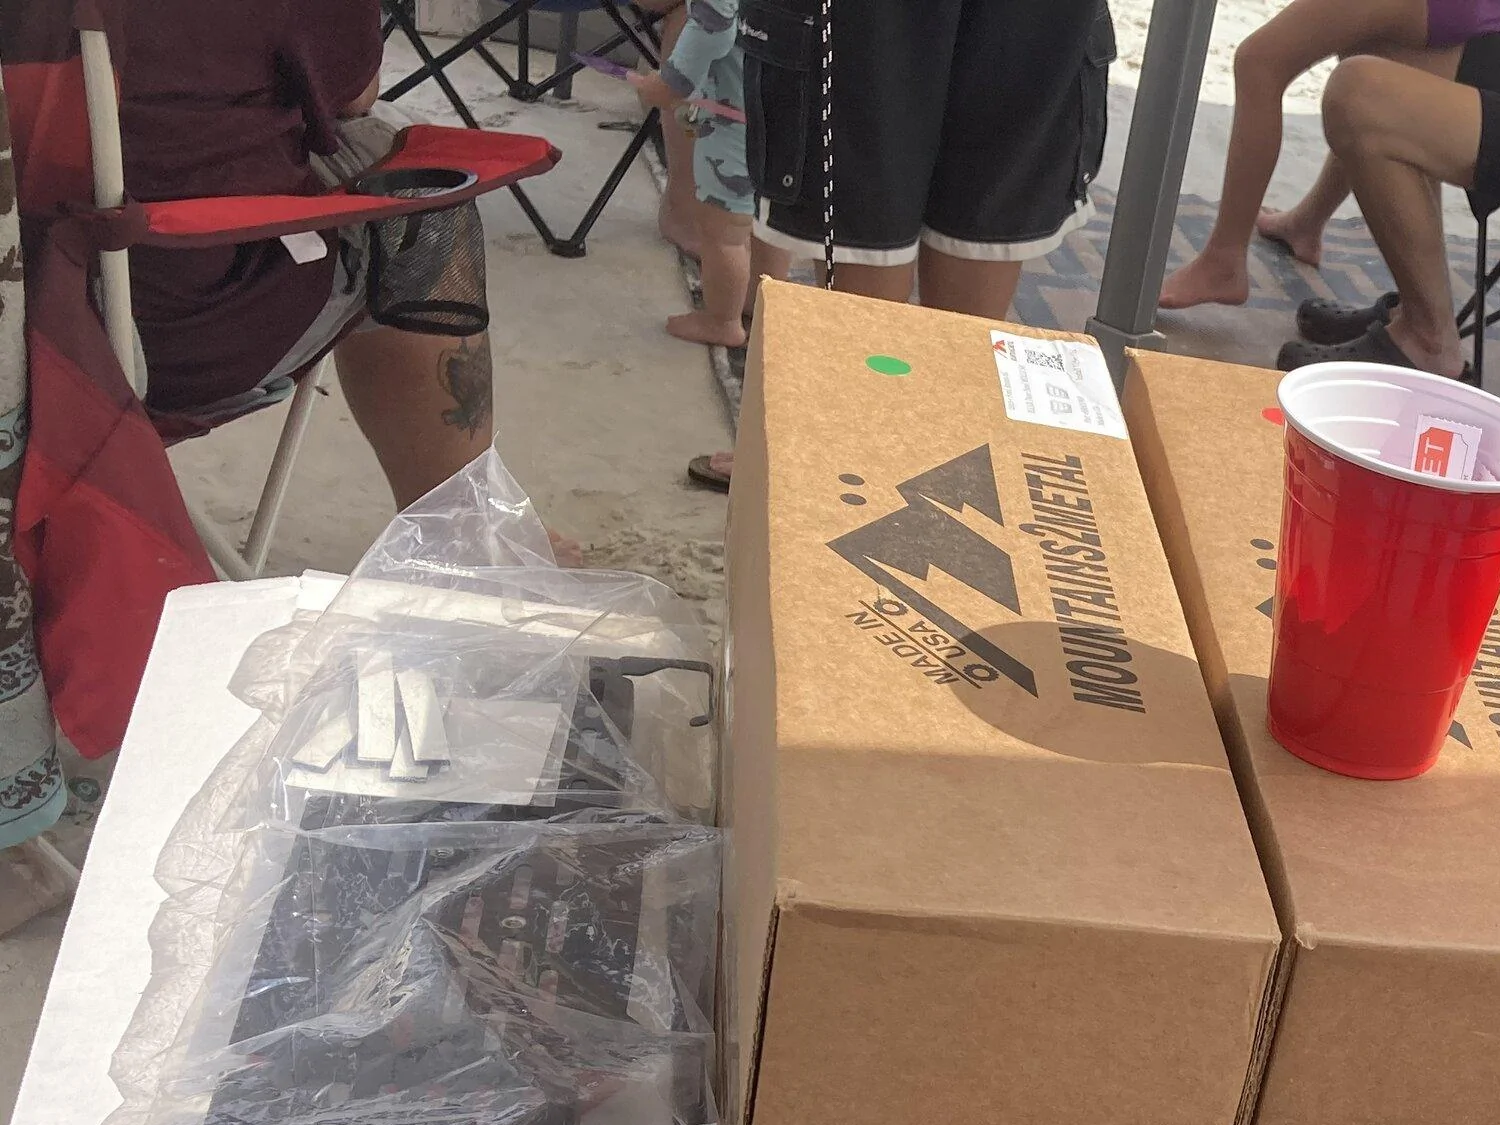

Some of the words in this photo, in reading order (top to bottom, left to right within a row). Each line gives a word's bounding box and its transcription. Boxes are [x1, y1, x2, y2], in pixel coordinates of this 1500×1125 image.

[1019, 451, 1147, 714] MOUNTAINS2METAL
[845, 611, 878, 631] IN
[908, 622, 968, 661] USA
[873, 634, 961, 688] MADE
